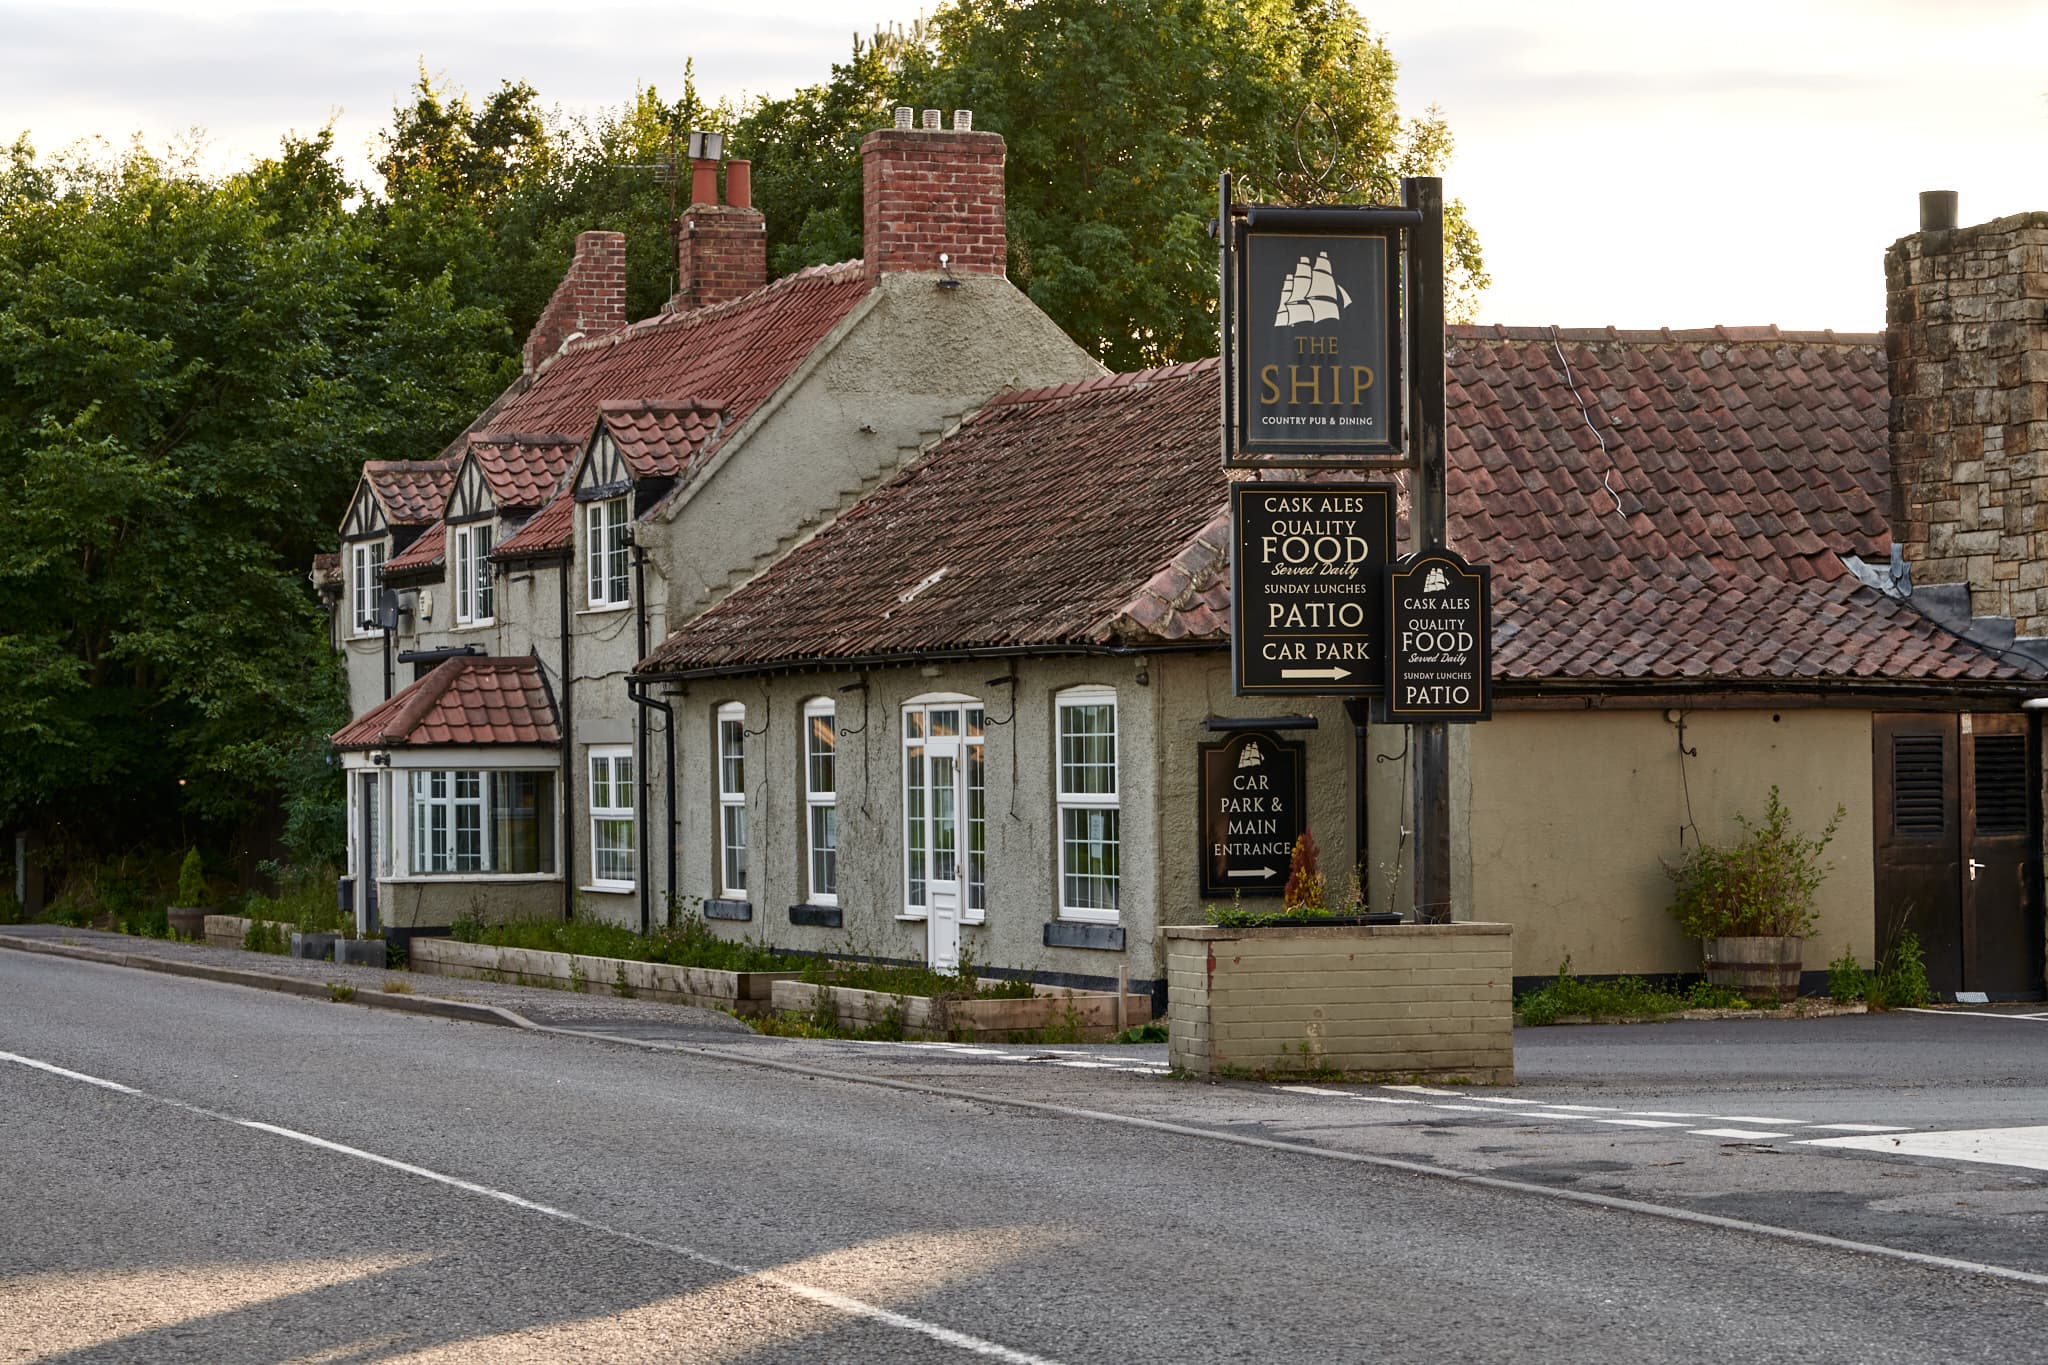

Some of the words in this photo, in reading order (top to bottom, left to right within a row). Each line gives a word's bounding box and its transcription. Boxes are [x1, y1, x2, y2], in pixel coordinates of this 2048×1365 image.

[1295, 336, 1339, 354] THE
[1260, 364, 1374, 405] SHIP
[1262, 416, 1307, 425] COUNTRY
[1309, 416, 1327, 425] PUB
[1329, 416, 1336, 425] &
[1339, 416, 1373, 426] DINING
[1264, 497, 1313, 513] CASK
[1319, 497, 1364, 513] ALES
[1271, 520, 1356, 536] QUALITY
[1261, 536, 1369, 564] FOOD
[1271, 562, 1318, 576] Served
[1319, 561, 1359, 580] Daily
[1264, 584, 1310, 594] SUNDAY
[1314, 584, 1367, 594] LUNCHES
[1403, 598, 1437, 610] CASK
[1441, 598, 1470, 610] ALES
[1268, 602, 1364, 628] PATIO
[1408, 619, 1465, 631] QUALITY
[1401, 631, 1473, 652] FOOD
[1262, 642, 1308, 660] CAR
[1316, 642, 1370, 660] PARK
[1408, 653, 1439, 663] Served
[1440, 652, 1467, 666] Daily
[1403, 672, 1435, 680] SUNDAY
[1436, 672, 1472, 680] LUNCHES
[1406, 686, 1470, 705] PATIO
[1233, 775, 1269, 790] CAR
[1220, 797, 1265, 813] PARK
[1271, 797, 1283, 812] &
[1228, 819, 1276, 835] MAIN
[1214, 842, 1291, 856] ENTRANCE
